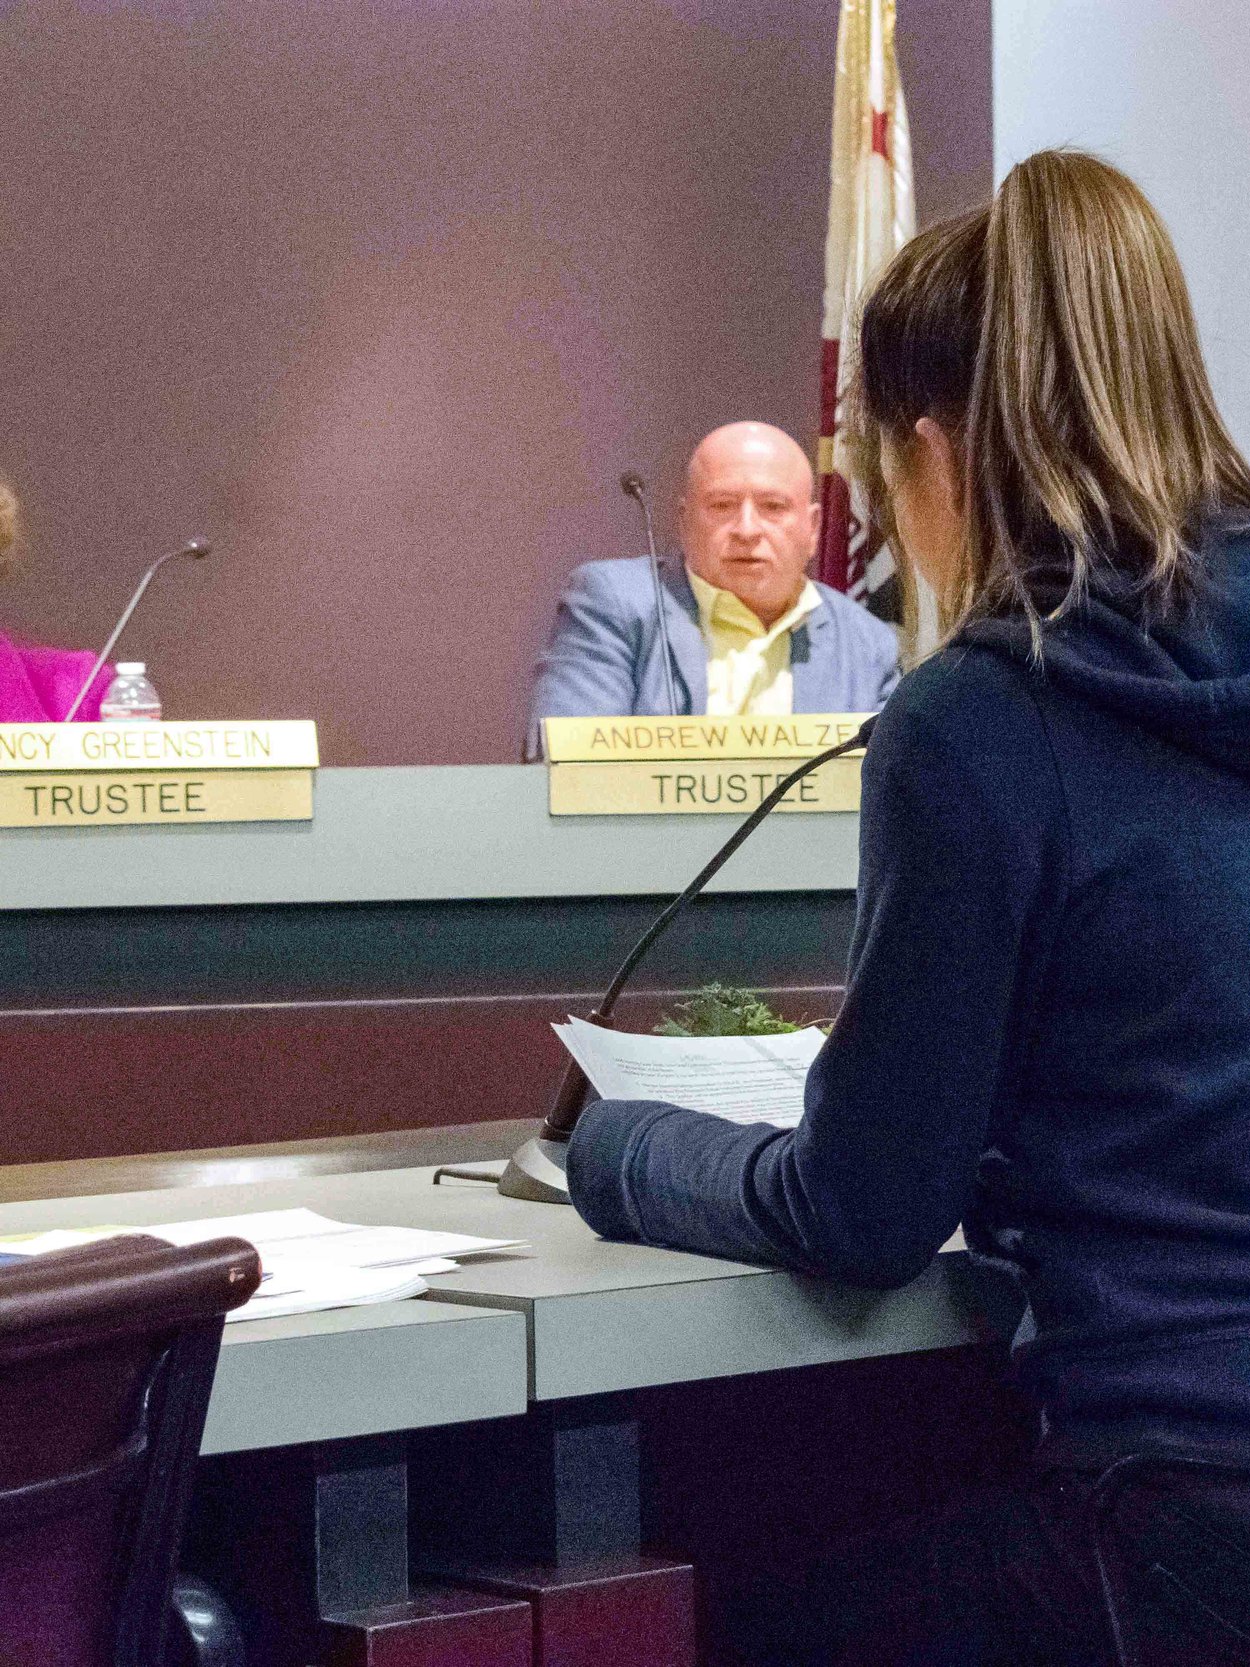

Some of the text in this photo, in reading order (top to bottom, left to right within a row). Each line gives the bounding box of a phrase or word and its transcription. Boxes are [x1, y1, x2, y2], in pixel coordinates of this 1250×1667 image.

[81, 730, 272, 759] GREENSTEIN
[590, 722, 862, 749] ANDREW WALZE
[24, 781, 207, 817] TRUSTEE
[651, 772, 820, 805] TRUSTEE
